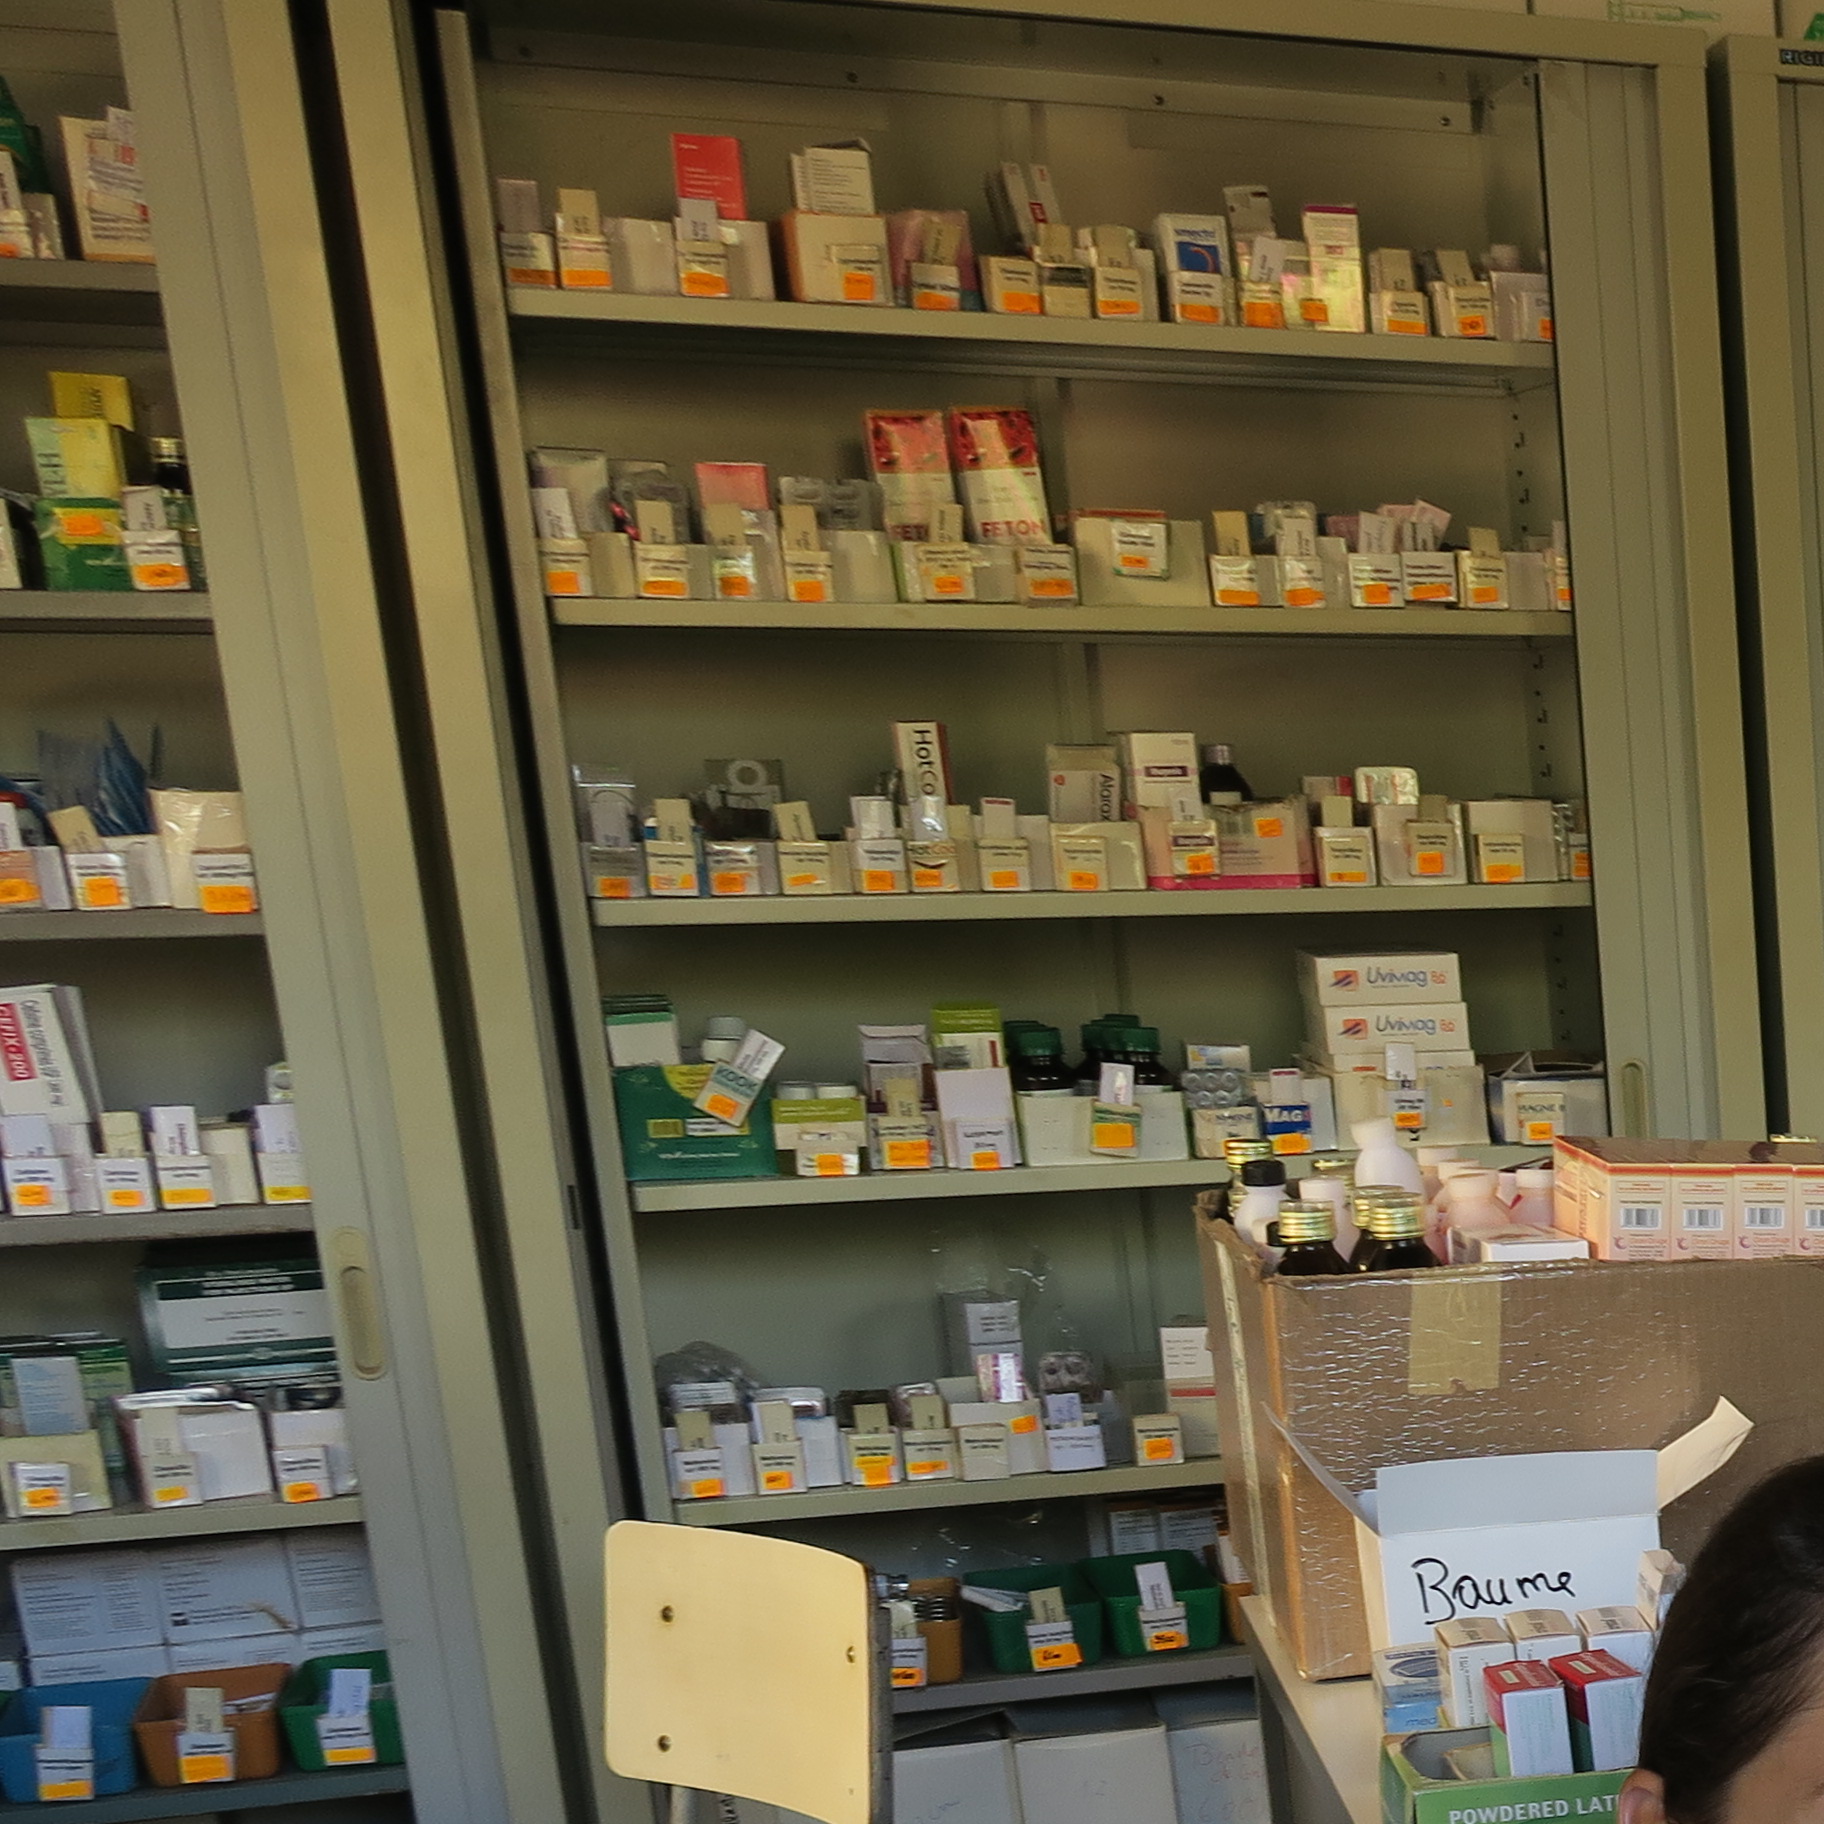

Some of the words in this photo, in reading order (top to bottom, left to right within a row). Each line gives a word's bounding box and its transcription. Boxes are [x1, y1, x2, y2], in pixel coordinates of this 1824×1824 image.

[913, 729, 939, 795] HotCo
[1367, 967, 1428, 987] Uvimag
[1375, 1014, 1436, 1035] Uvimag
[1411, 1558, 1576, 1624] Baume
